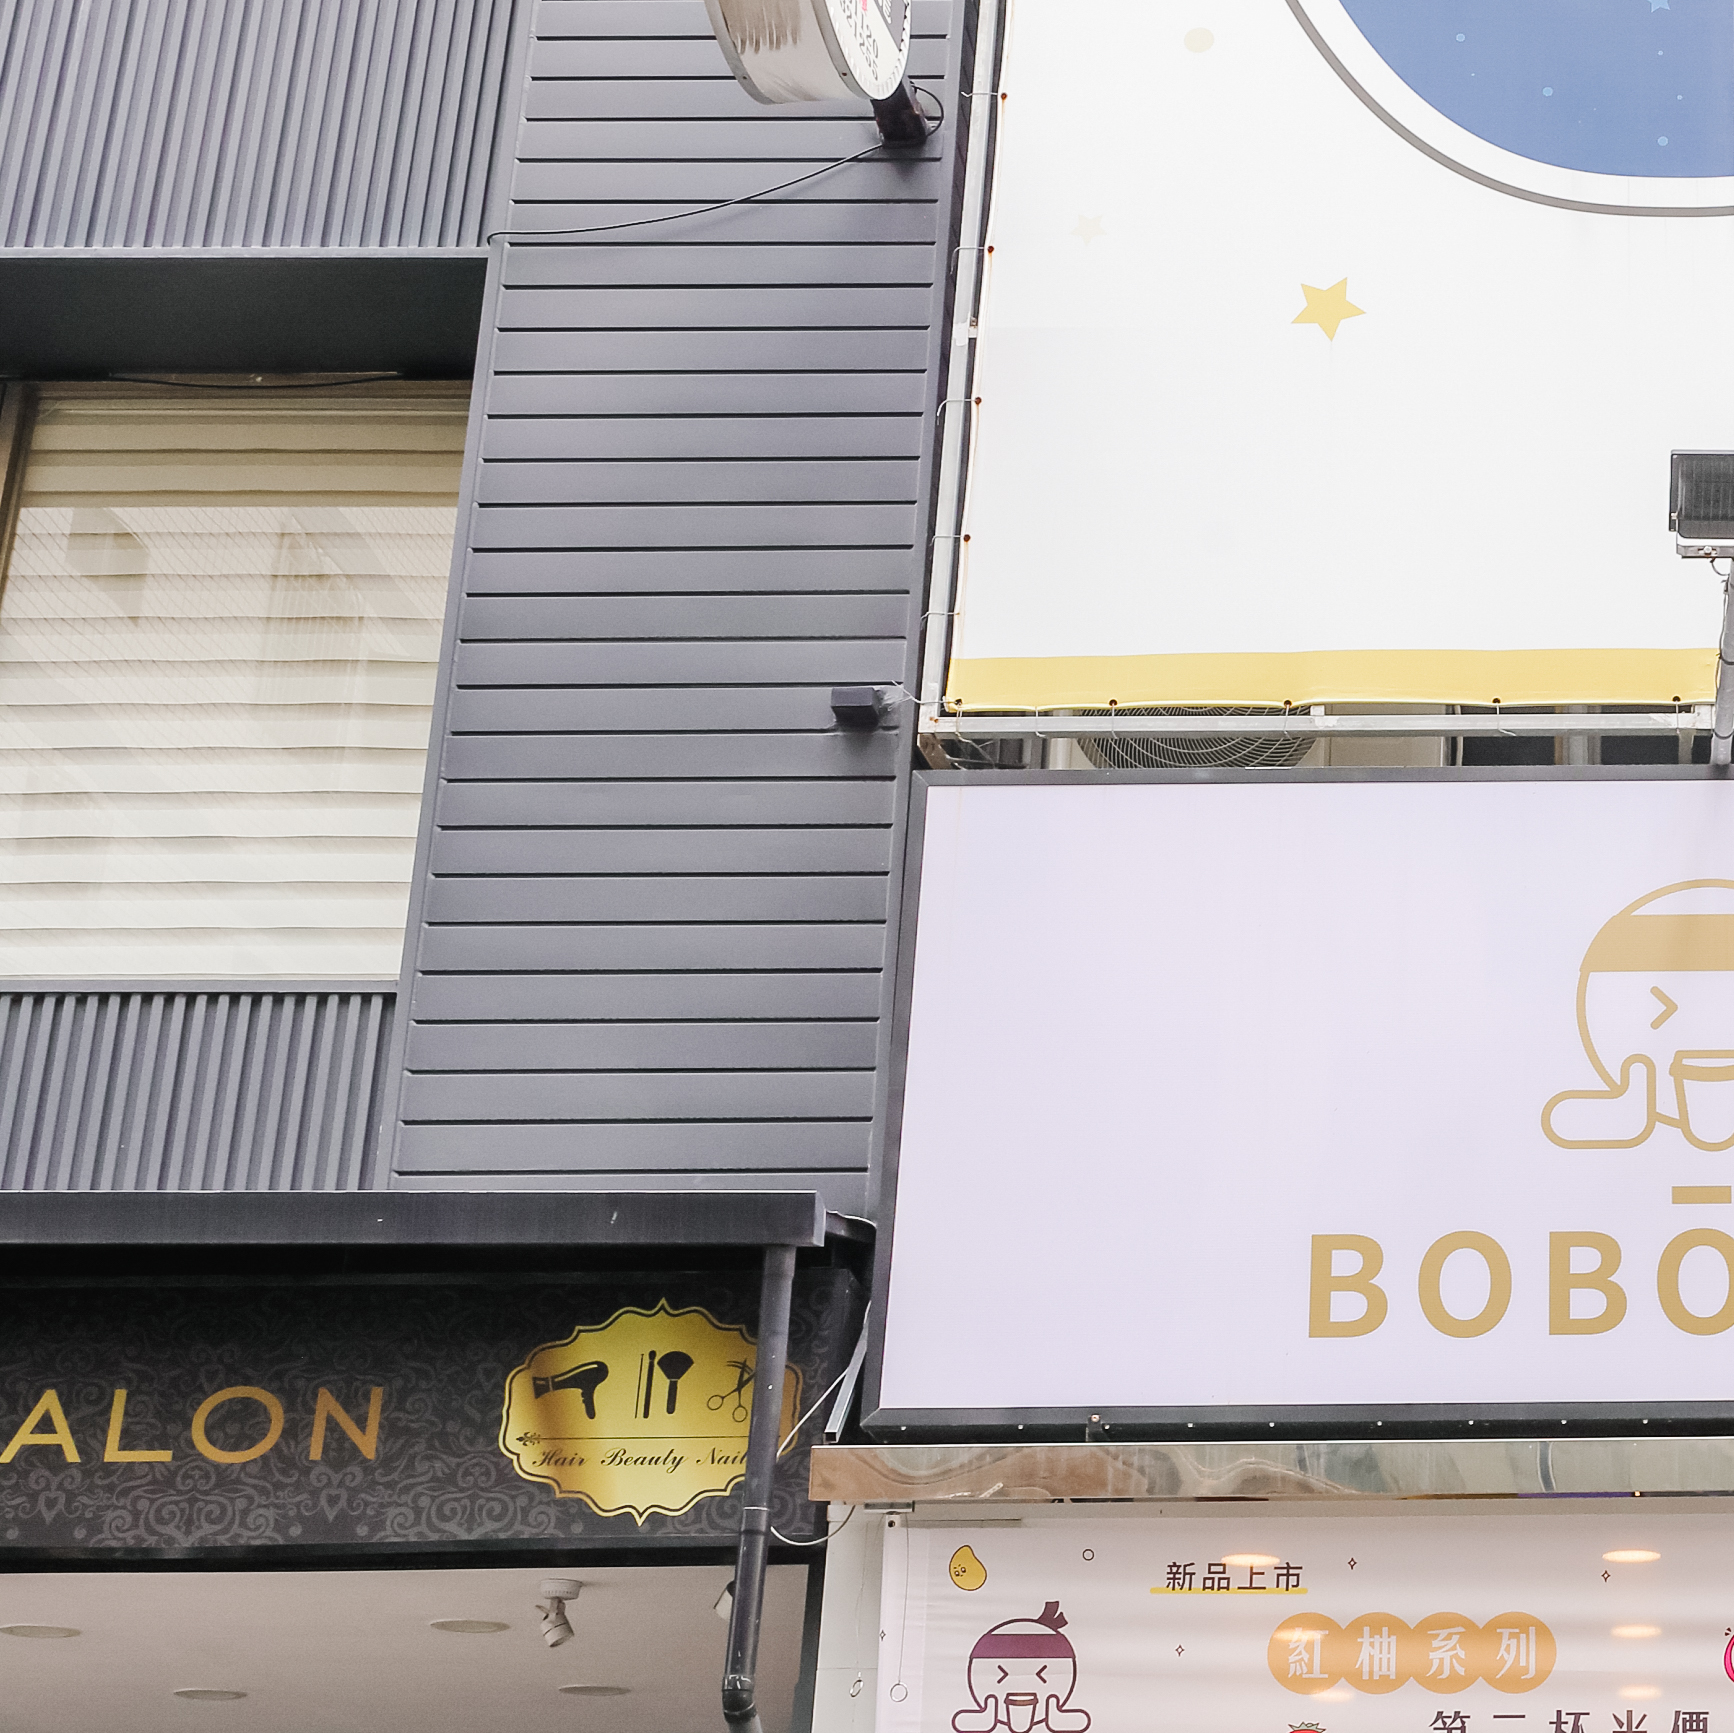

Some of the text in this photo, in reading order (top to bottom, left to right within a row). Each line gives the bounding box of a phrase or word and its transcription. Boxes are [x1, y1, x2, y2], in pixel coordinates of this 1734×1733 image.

[532, 1447, 588, 1468] Hair
[600, 1447, 687, 1473] Beauty
[1164, 1561, 1305, 1594] 新品上市
[1286, 1625, 1538, 1682] 紅柚系列
